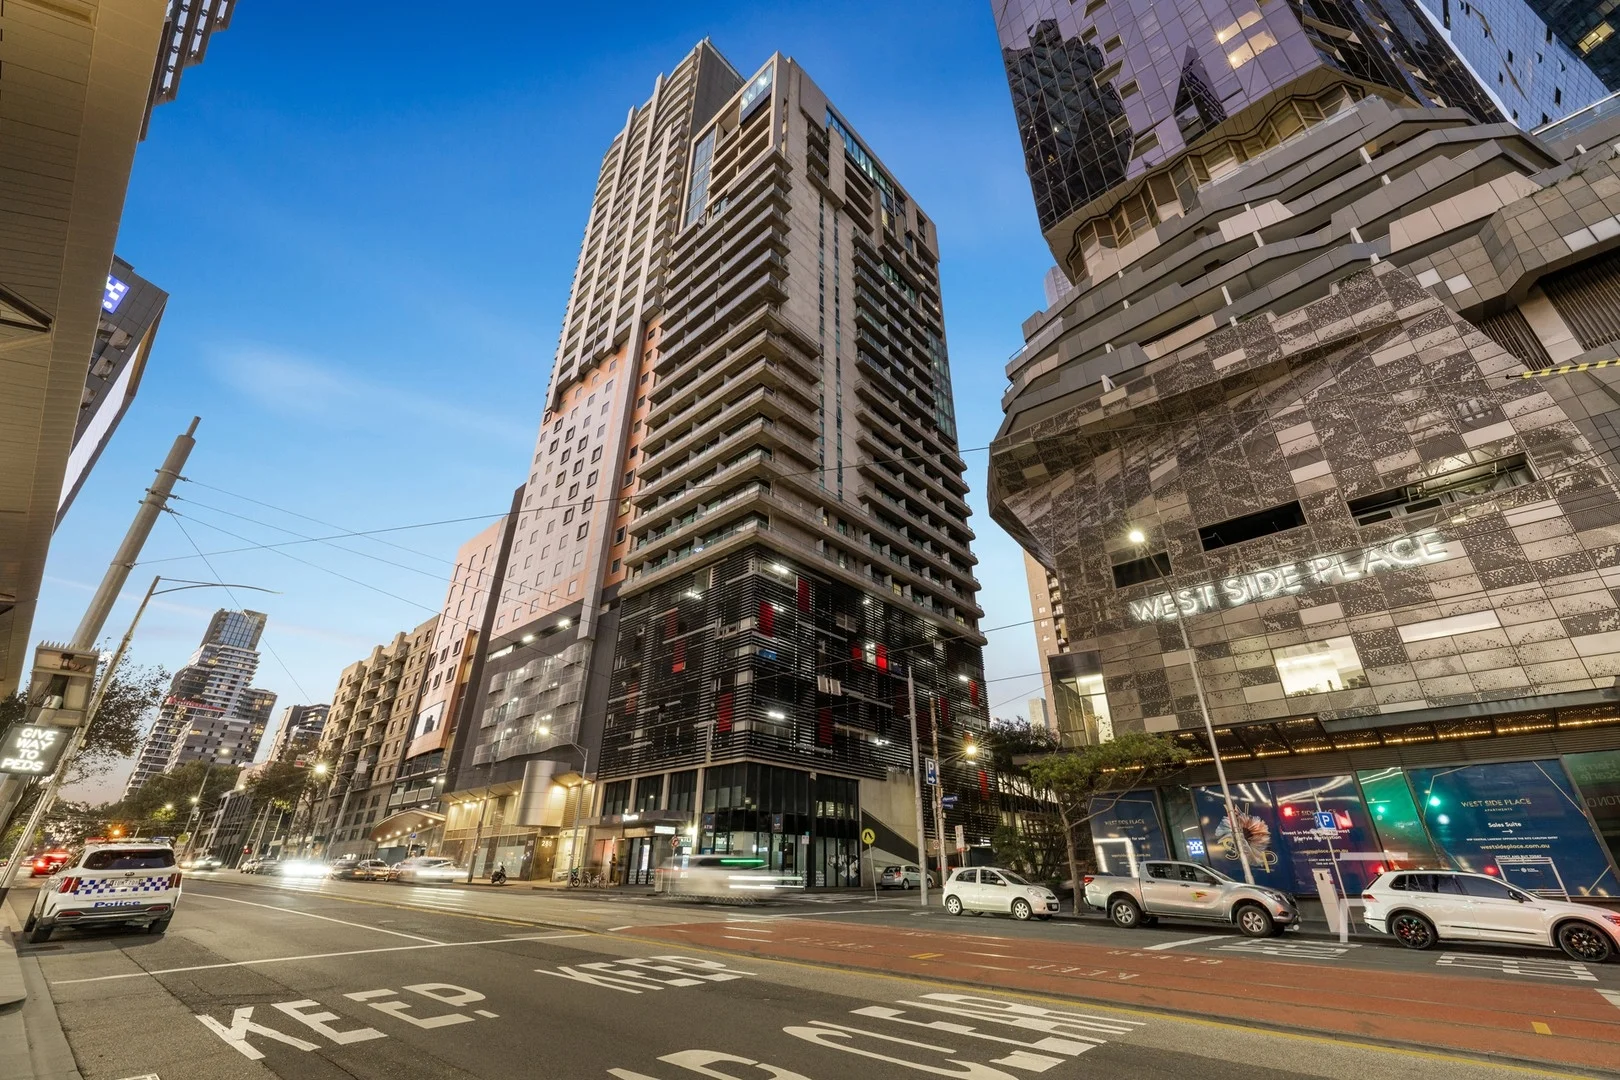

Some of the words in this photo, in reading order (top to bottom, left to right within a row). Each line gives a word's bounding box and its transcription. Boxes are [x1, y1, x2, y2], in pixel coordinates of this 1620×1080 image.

[1129, 582, 1214, 621] WEST
[1223, 565, 1303, 605] SIDE
[1311, 530, 1449, 580] PLACE
[21, 727, 58, 741] GIVE
[16, 737, 54, 751] WAY
[19, 748, 39, 760] TO
[1, 757, 45, 771] PEDS
[928, 761, 935, 774] P
[1461, 800, 1482, 808] WEST
[1484, 799, 1503, 807] SIDE
[1505, 798, 1532, 806] PLACE
[1322, 815, 1330, 826] P
[94, 900, 141, 908] Police
[533, 955, 758, 994] KEEP
[195, 983, 500, 1060] KEEP
[782, 993, 1147, 1080] CLEAR
